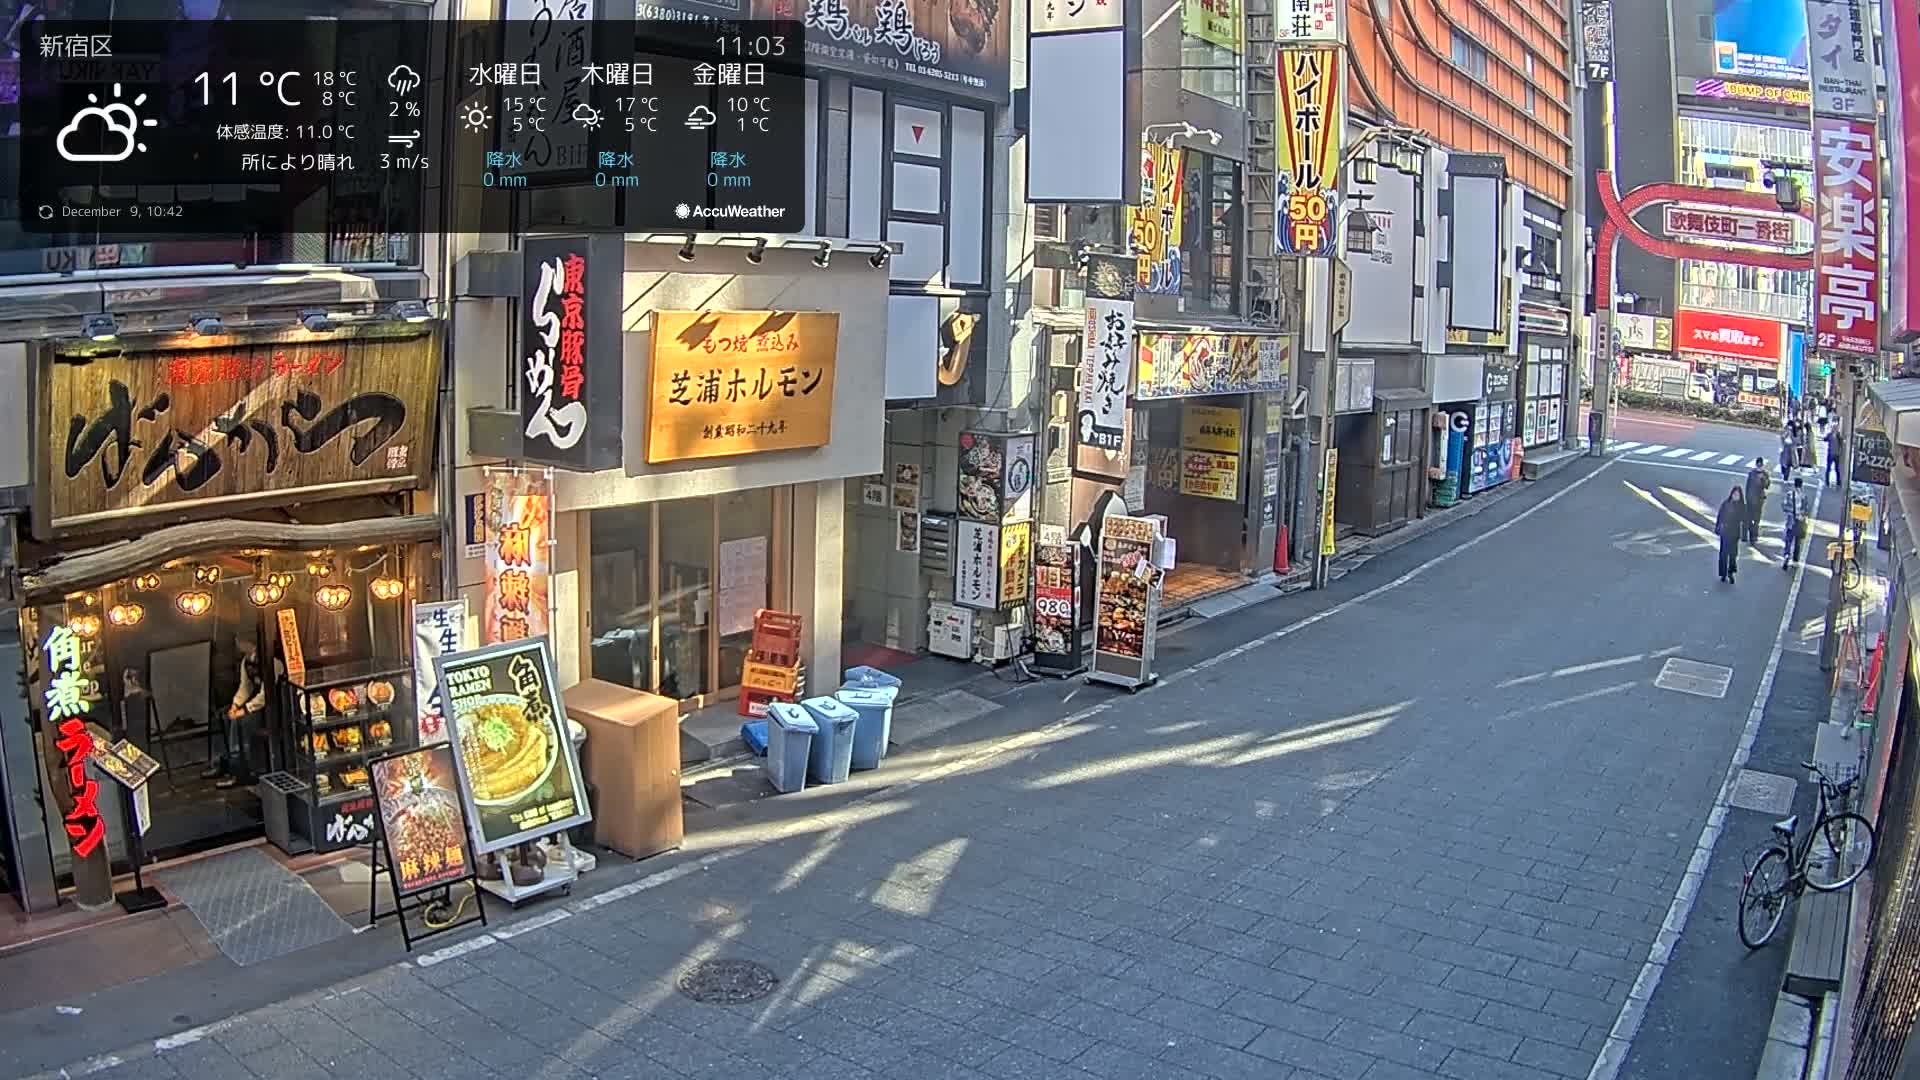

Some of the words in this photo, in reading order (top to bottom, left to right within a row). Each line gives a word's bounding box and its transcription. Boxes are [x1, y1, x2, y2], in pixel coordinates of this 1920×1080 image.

[1816, 13, 1842, 70] タイ
[1588, 63, 1610, 79] 7F
[1765, 87, 1781, 100] OF
[1294, 53, 1323, 191] ハイボール
[1161, 152, 1176, 288] ハイボール
[1289, 194, 1326, 222] 50
[1134, 219, 1157, 251] 50
[1294, 223, 1320, 251] 円
[1670, 210, 1792, 242] 歌舞伎町一番街
[1820, 126, 1876, 330] 安楽亭
[554, 252, 586, 400] 東京豚骨
[1818, 332, 1836, 347] 2F
[702, 334, 750, 354] もつ焼
[756, 332, 801, 353] 煮込み
[1097, 309, 1128, 415] お好み焼き
[668, 366, 824, 406] 芝浦ホルモン
[702, 420, 789, 441] 創業昭和二十九年
[1098, 433, 1122, 448] B1F
[445, 665, 491, 685] TOKYO
[449, 678, 493, 699] RAMEN
